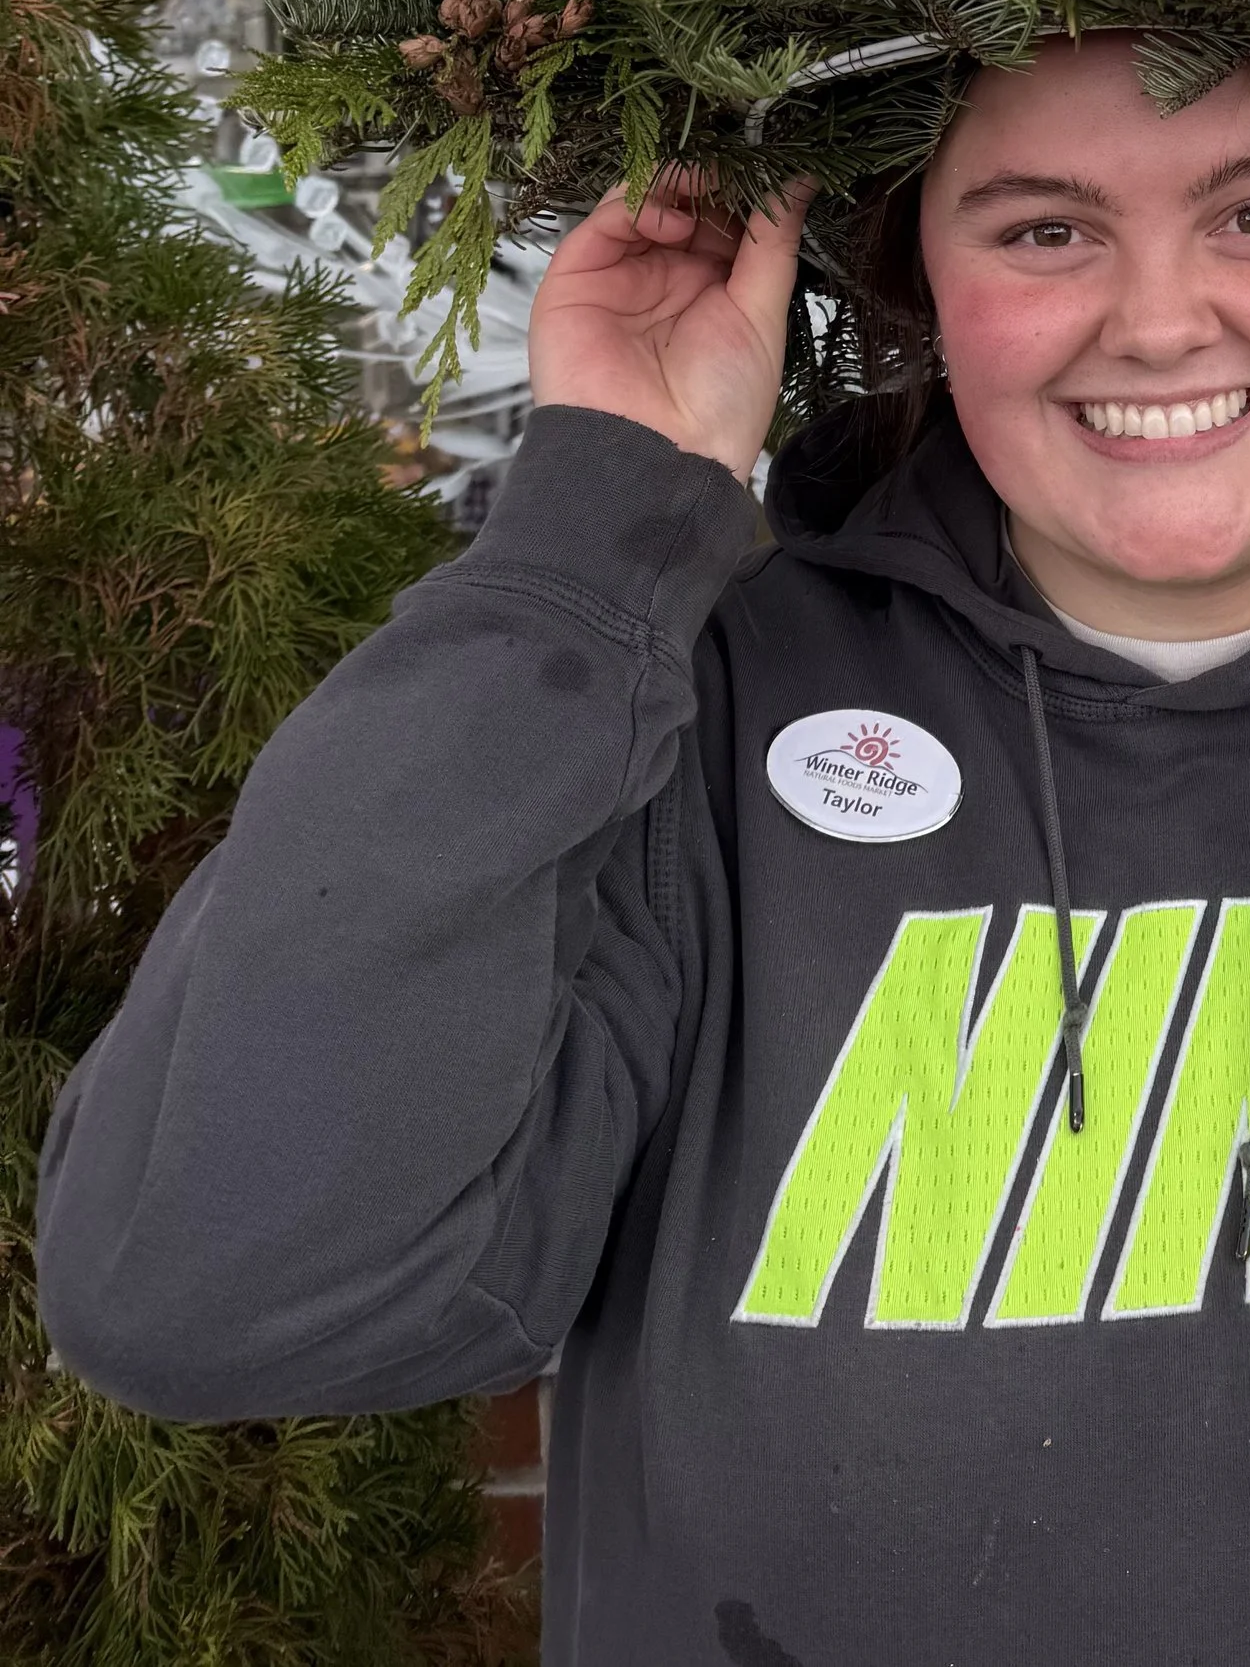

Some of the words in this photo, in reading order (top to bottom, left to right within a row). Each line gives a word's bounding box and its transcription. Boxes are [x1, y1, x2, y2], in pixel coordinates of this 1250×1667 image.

[803, 770, 837, 784] NATURAL
[837, 778, 862, 791] FOODS
[862, 784, 892, 798] MARKET
[805, 755, 864, 781] Winter
[866, 770, 918, 796] Ridge
[822, 788, 884, 817] Taylor
